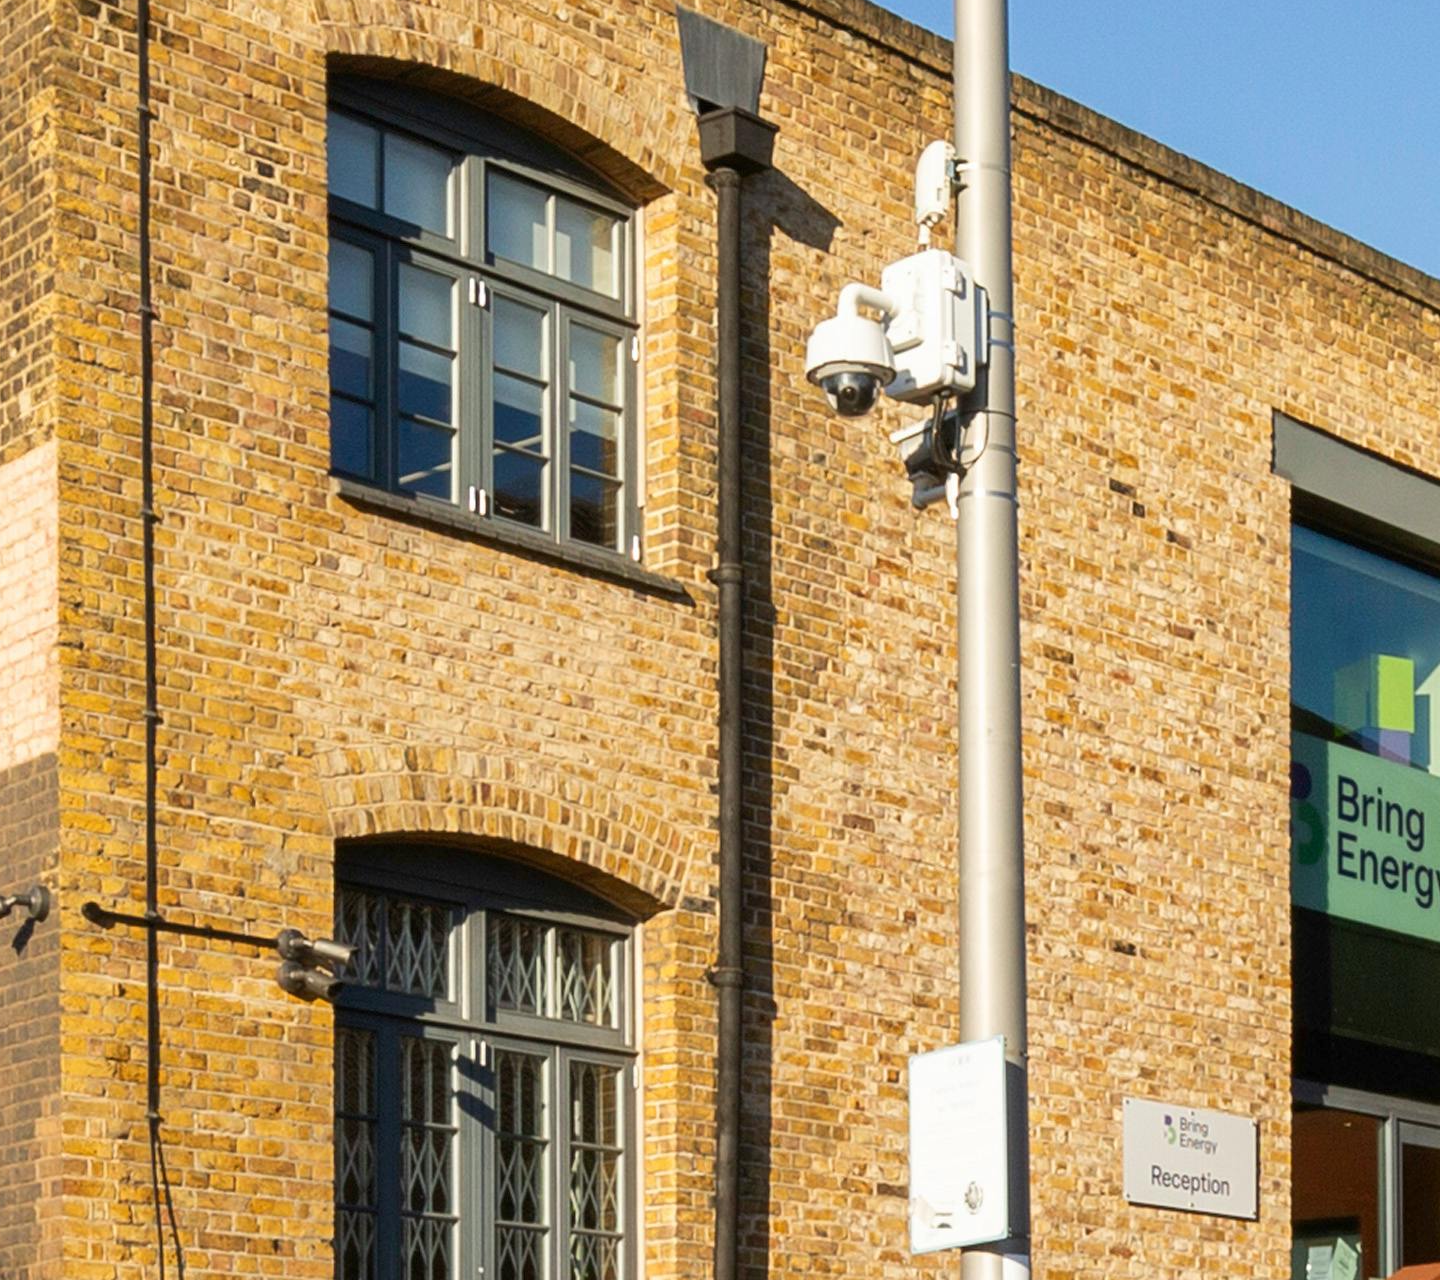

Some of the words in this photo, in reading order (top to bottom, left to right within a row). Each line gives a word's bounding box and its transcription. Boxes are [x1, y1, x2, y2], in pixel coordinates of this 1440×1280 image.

[1337, 775, 1425, 852] Bring
[1179, 1116, 1209, 1138] Bring
[1179, 1133, 1218, 1154] Energy
[1151, 1165, 1230, 1197] Reception
